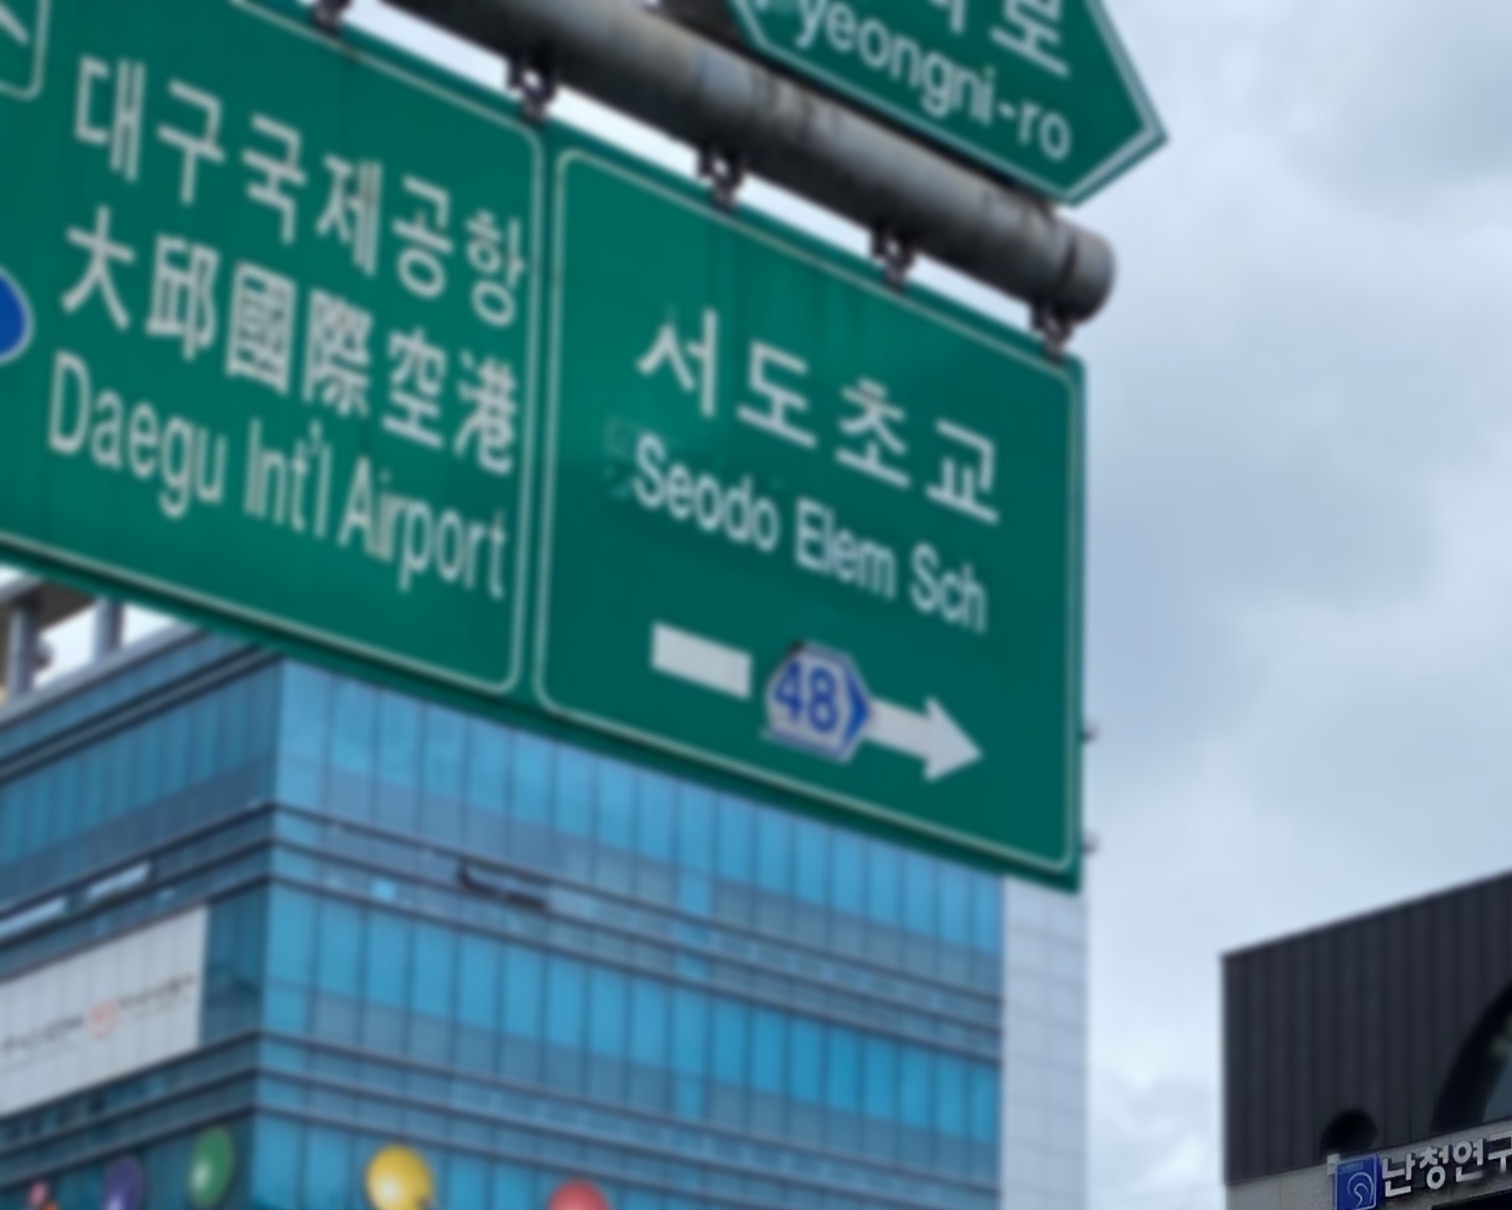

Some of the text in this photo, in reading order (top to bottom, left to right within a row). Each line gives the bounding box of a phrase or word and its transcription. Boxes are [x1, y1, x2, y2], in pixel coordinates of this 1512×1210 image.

[757, 0, 1072, 161] yeongni-ro
[75, 56, 525, 327] 대구국제공항
[61, 205, 517, 476] 大邱國際空港
[637, 308, 1000, 526] 서도초교
[49, 351, 509, 600] Daegu Int'l Airport
[632, 432, 988, 634] Seodo Elem Sch
[773, 657, 841, 740] 48
